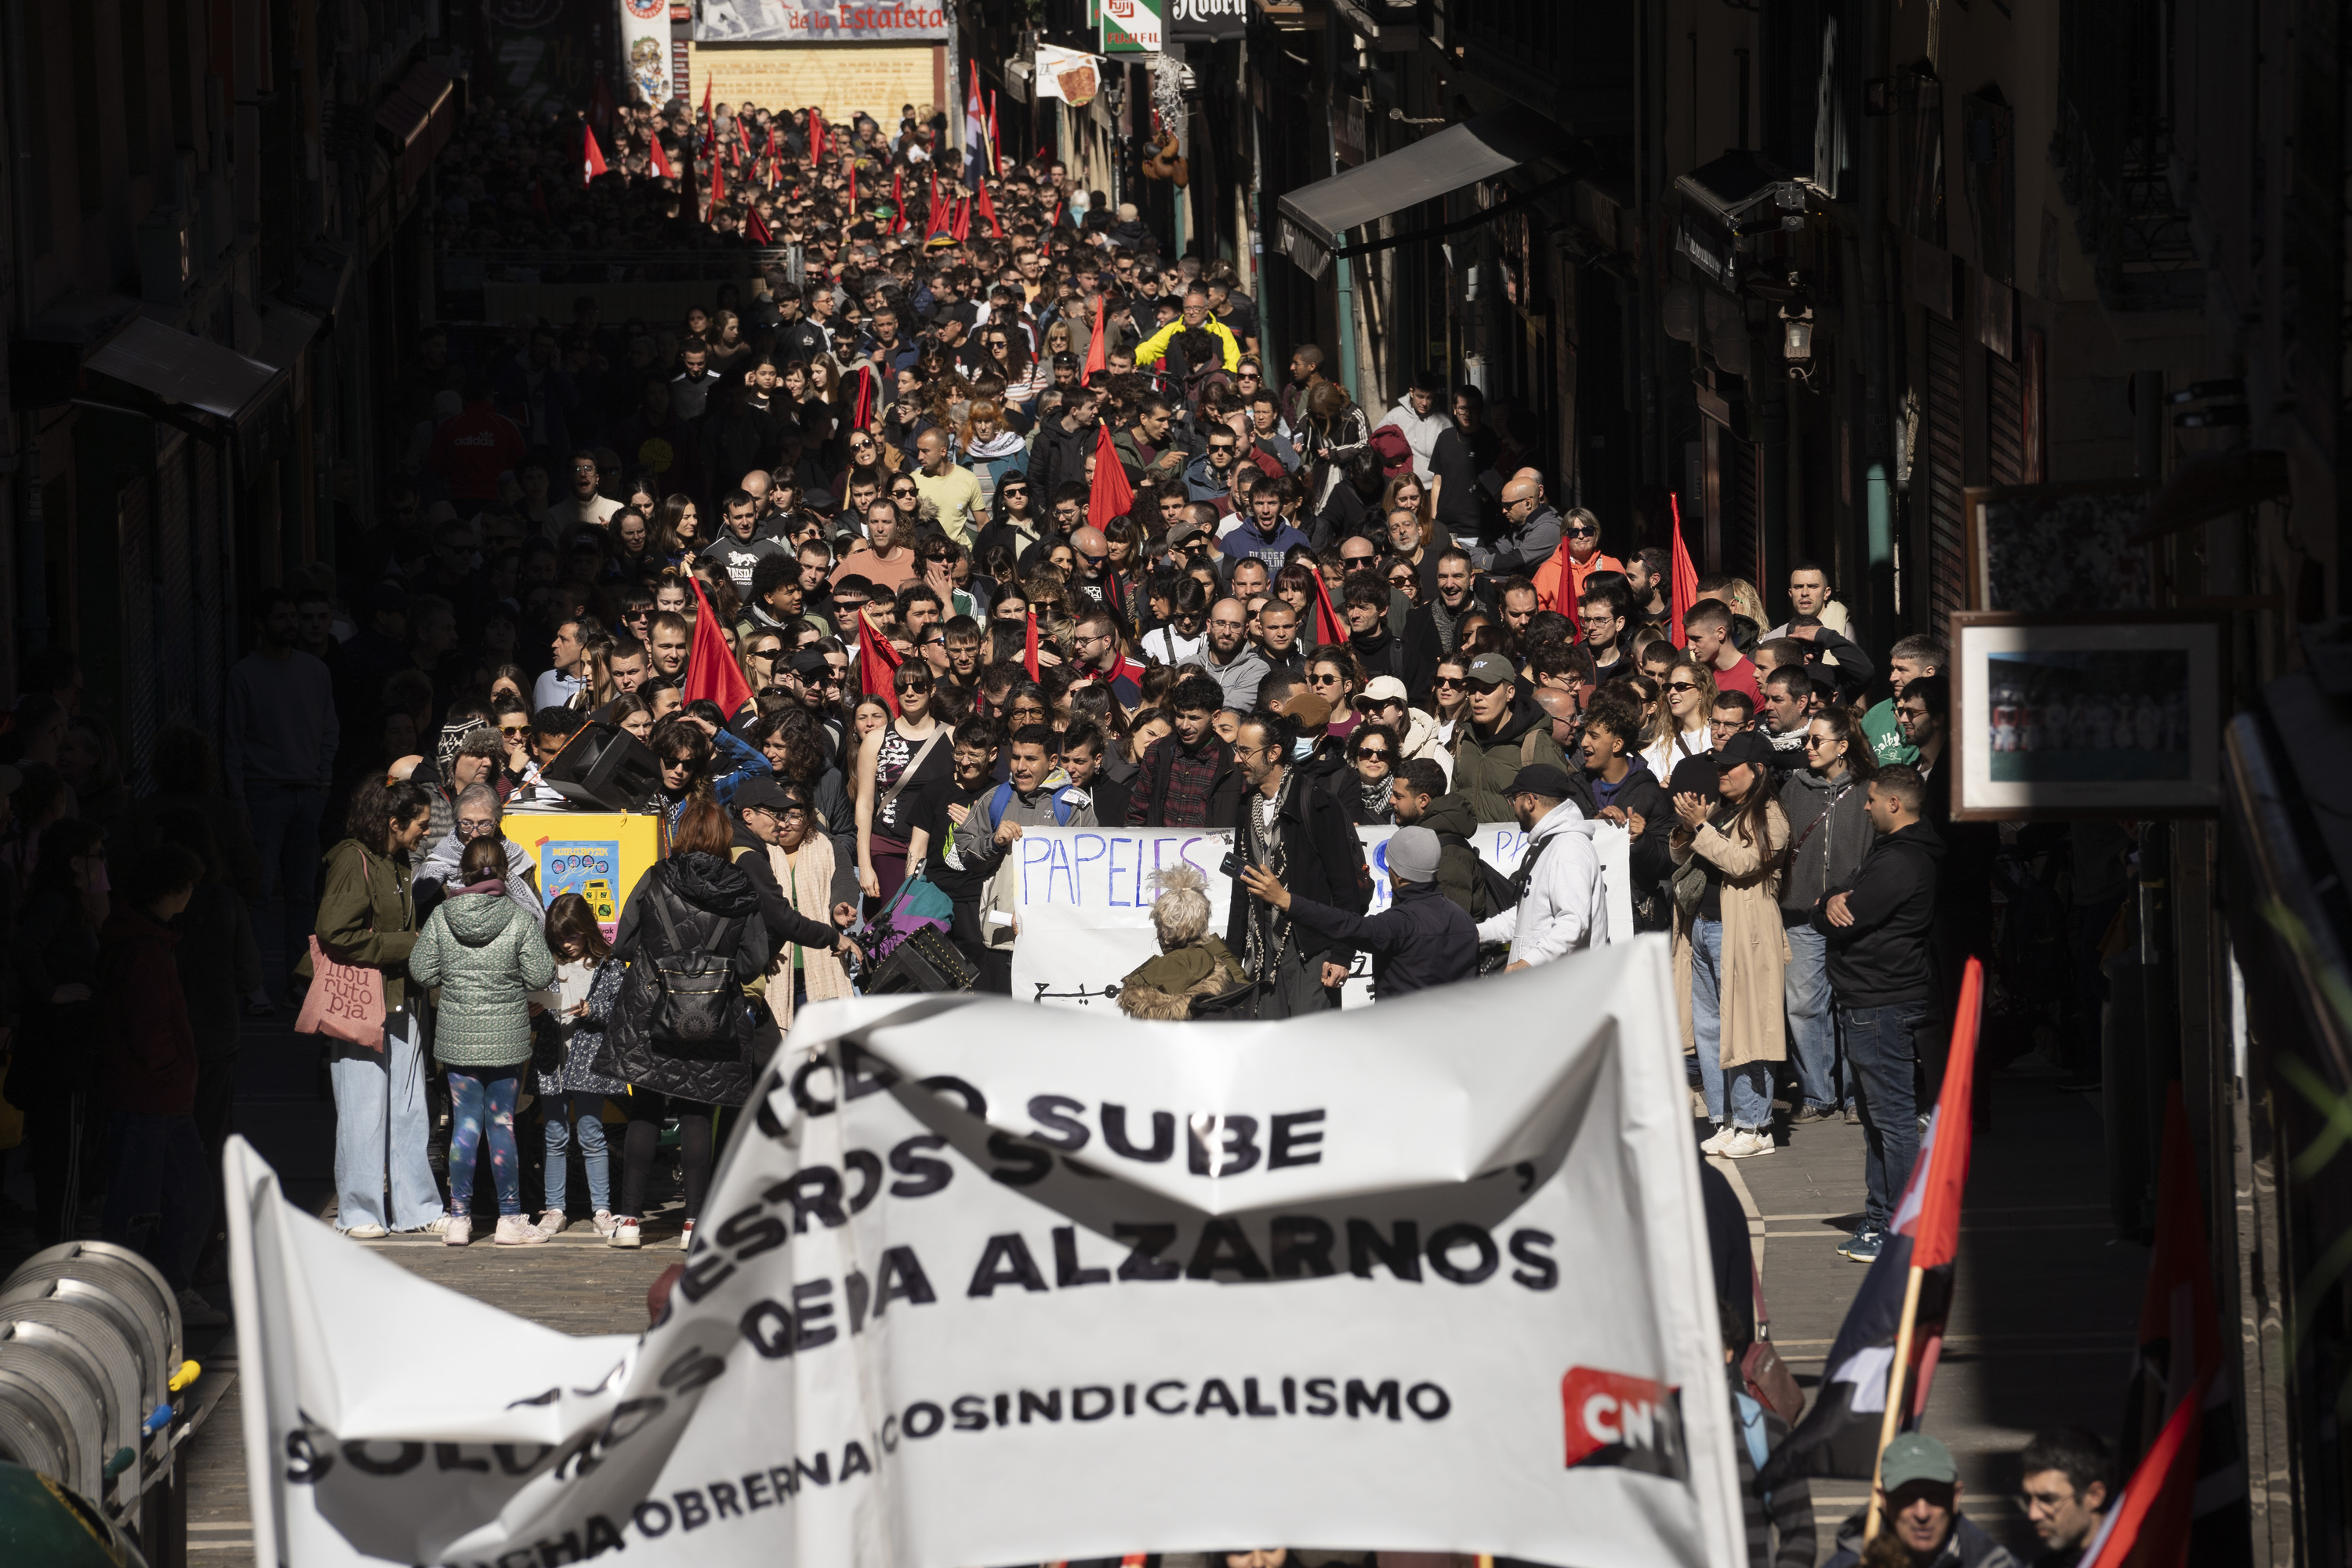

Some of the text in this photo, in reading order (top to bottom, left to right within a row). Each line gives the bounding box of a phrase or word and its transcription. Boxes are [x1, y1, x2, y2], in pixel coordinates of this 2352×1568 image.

[789, 3, 943, 29] de la Estafeta
[455, 435, 494, 446] adidas
[552, 848, 608, 856] MARABIYAK
[324, 978, 372, 1004] ruto
[325, 993, 368, 1020] pia
[1028, 1094, 1327, 1176] SUBE
[966, 1213, 1560, 1298] ALZARNOS
